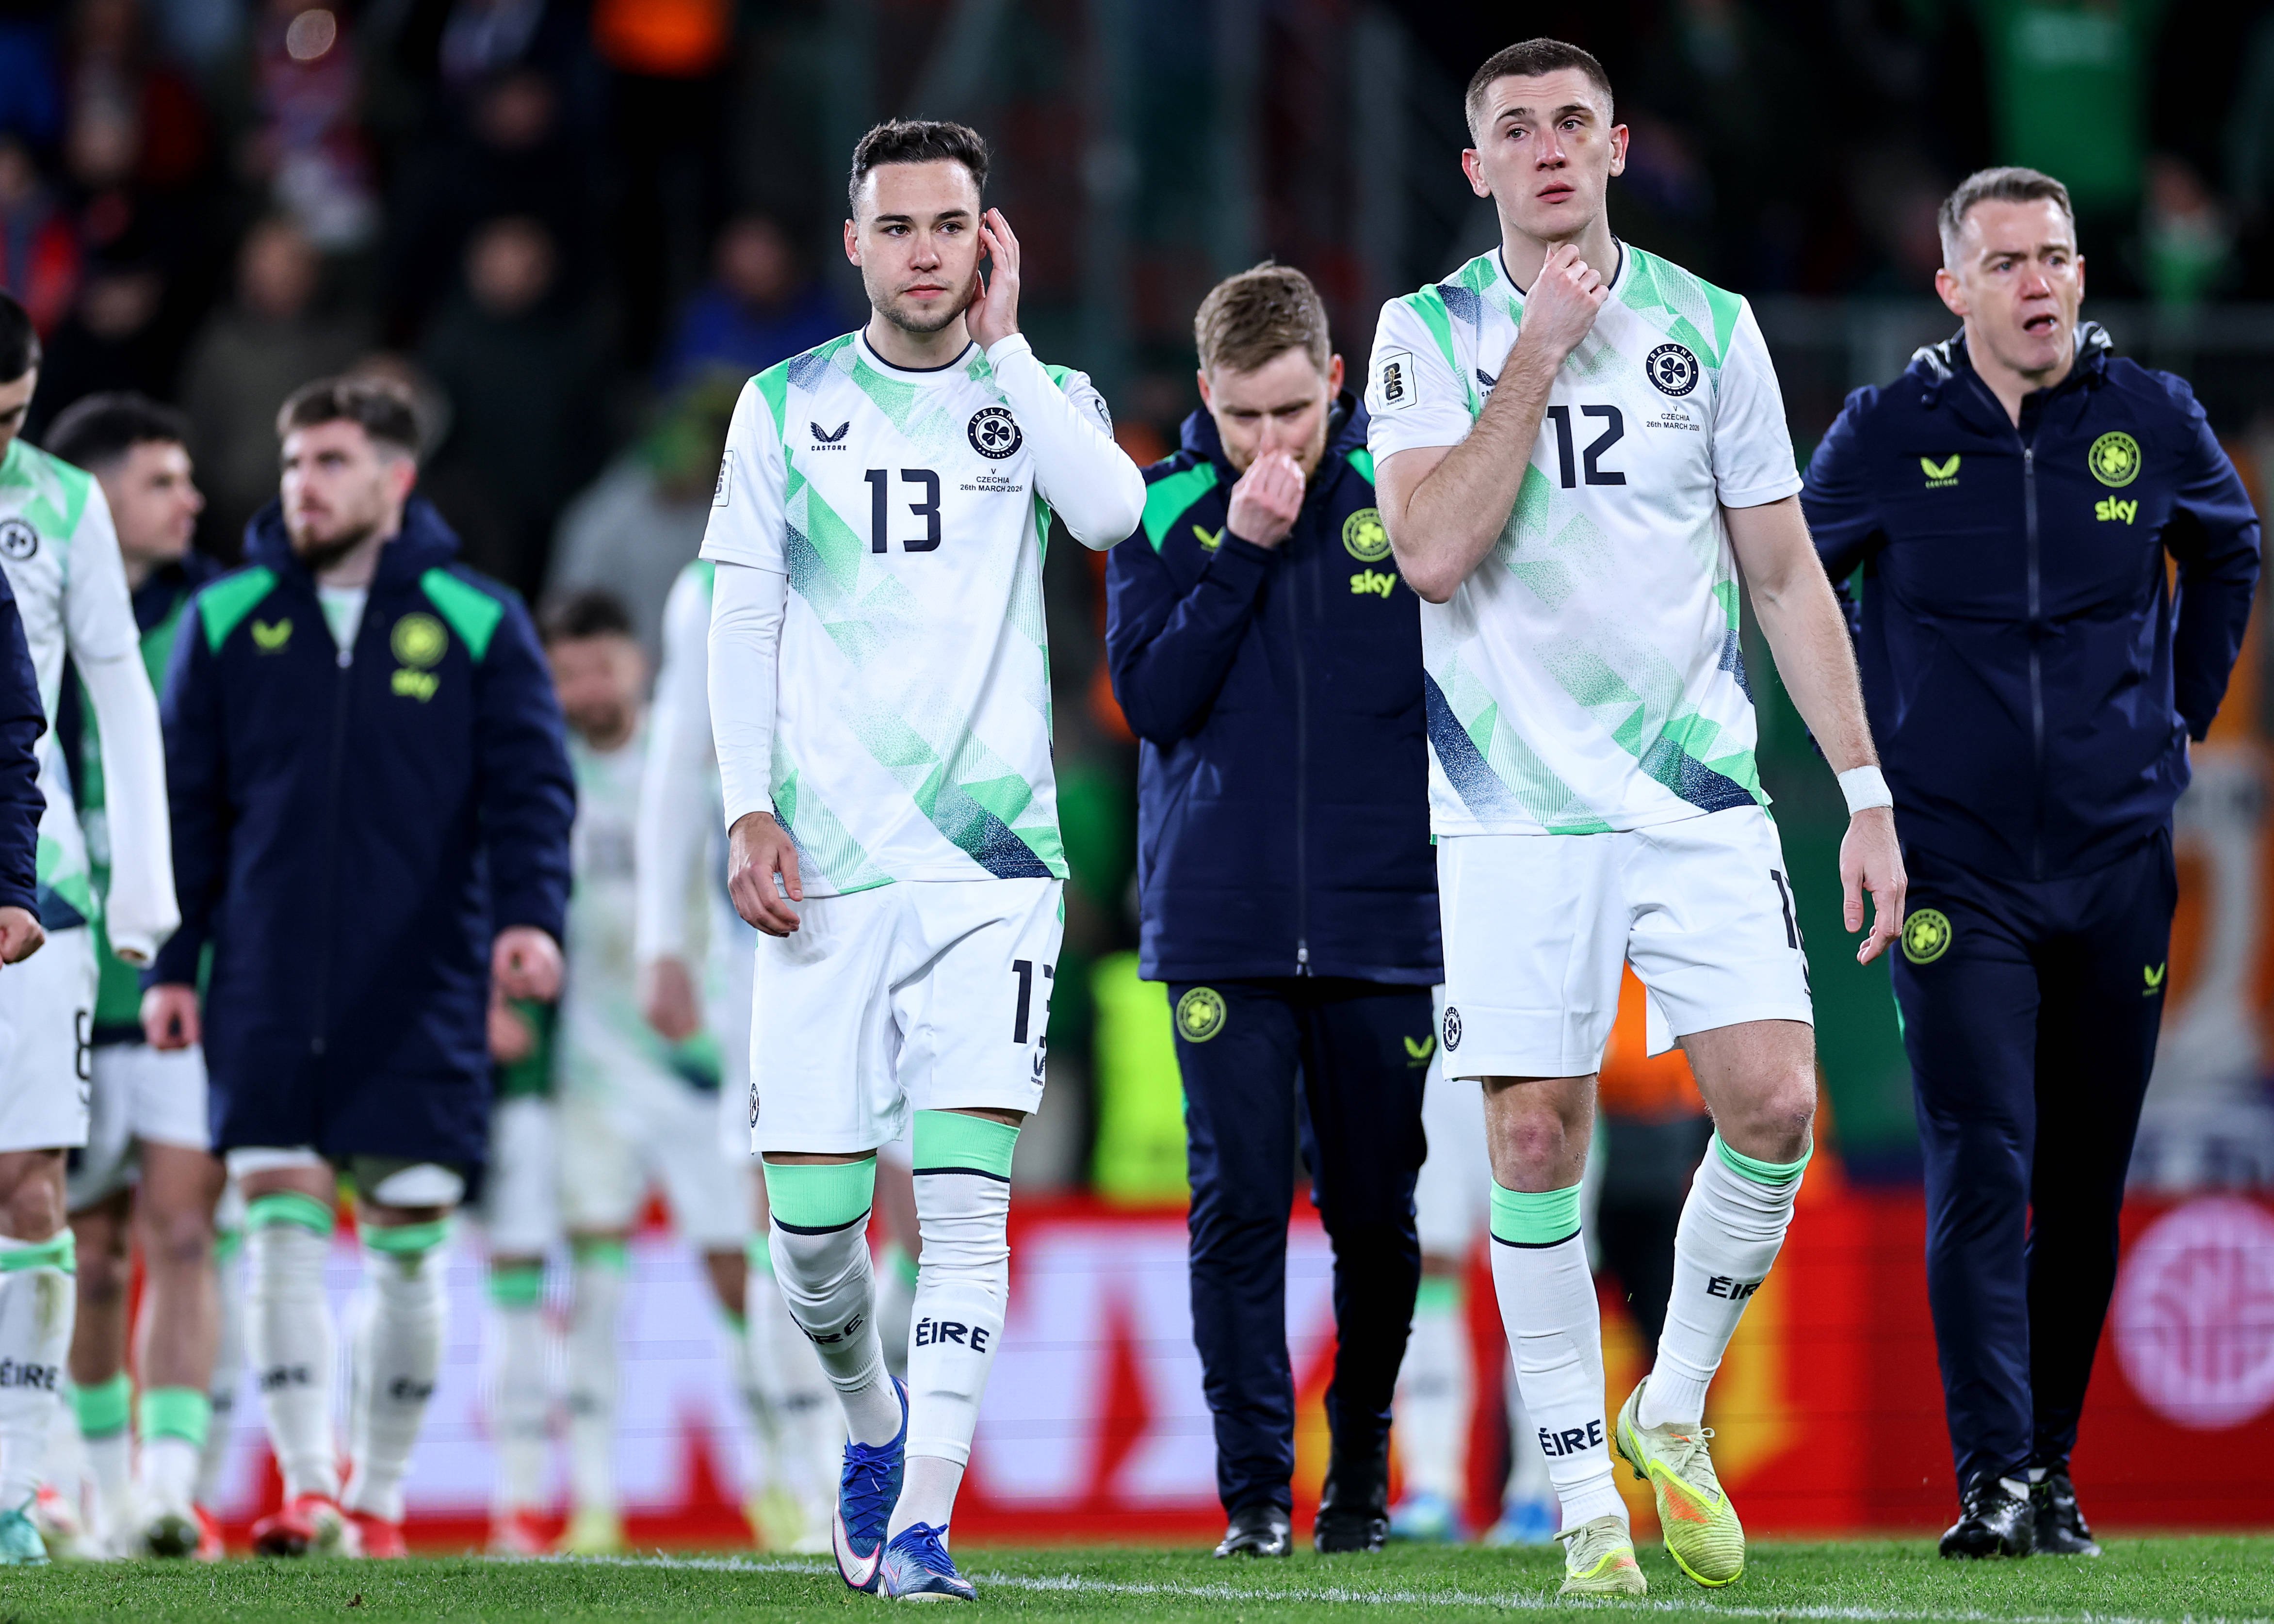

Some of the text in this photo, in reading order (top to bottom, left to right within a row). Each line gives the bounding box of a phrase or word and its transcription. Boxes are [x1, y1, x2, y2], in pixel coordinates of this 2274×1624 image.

[1647, 345, 1694, 364] IRELAND
[1659, 386, 1692, 395] FOOTBALL
[1664, 422, 1688, 430] MARCH
[978, 447, 1014, 458] FOOTBALL
[1547, 405, 1626, 488] 12
[864, 468, 941, 553] 13
[2095, 495, 2139, 525] sky
[1350, 568, 1397, 599] sky
[916, 1317, 990, 1353] ÉIRE
[1538, 1419, 1603, 1456] ÉIRE
